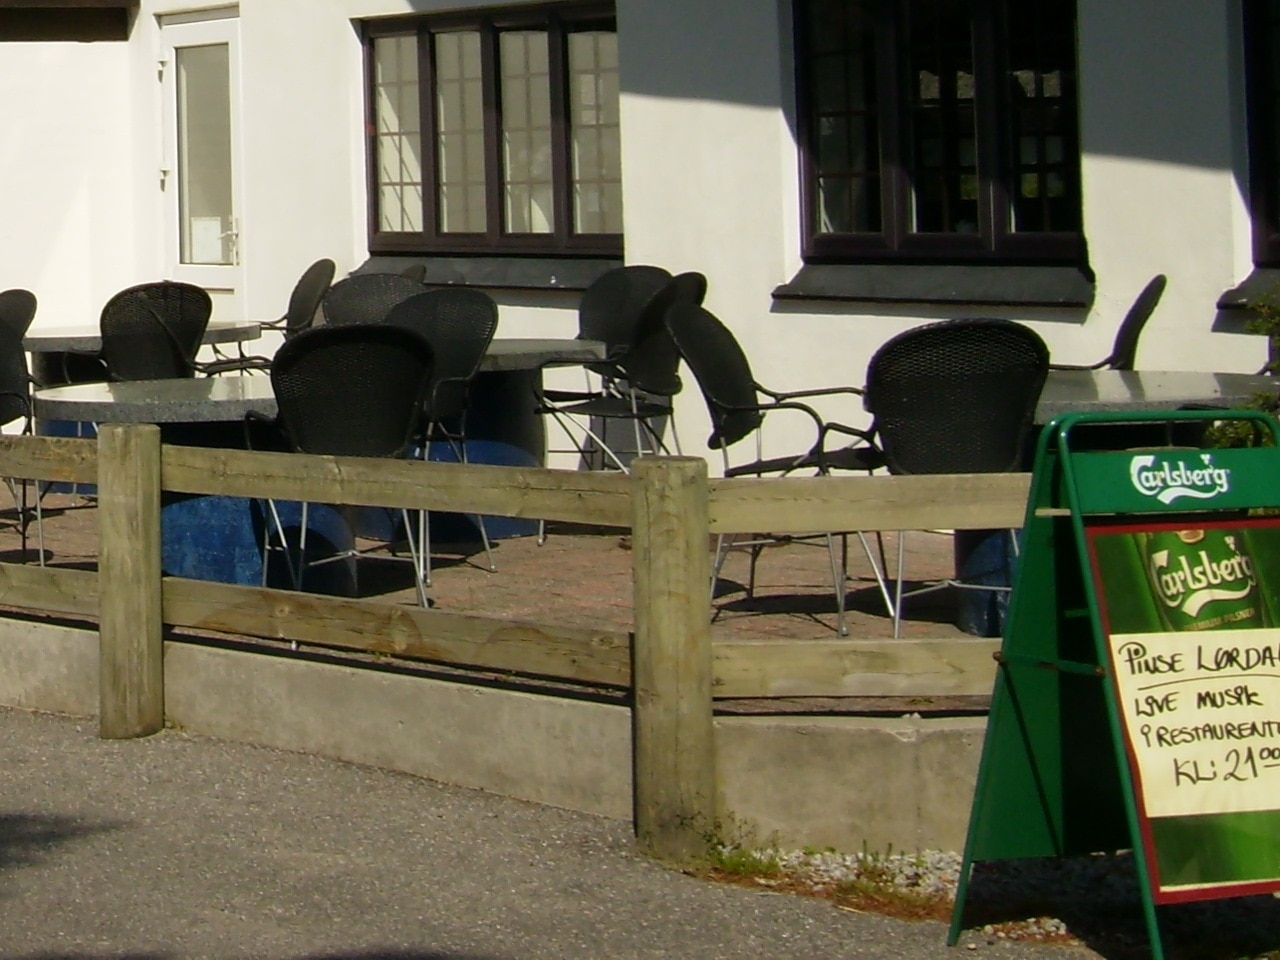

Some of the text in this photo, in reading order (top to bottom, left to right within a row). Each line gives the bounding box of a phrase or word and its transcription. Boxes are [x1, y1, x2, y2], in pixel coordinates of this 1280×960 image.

[1129, 453, 1229, 501] Carlsberg
[1151, 542, 1257, 612] Carlsberg
[1197, 644, 1280, 672] LØRDA
